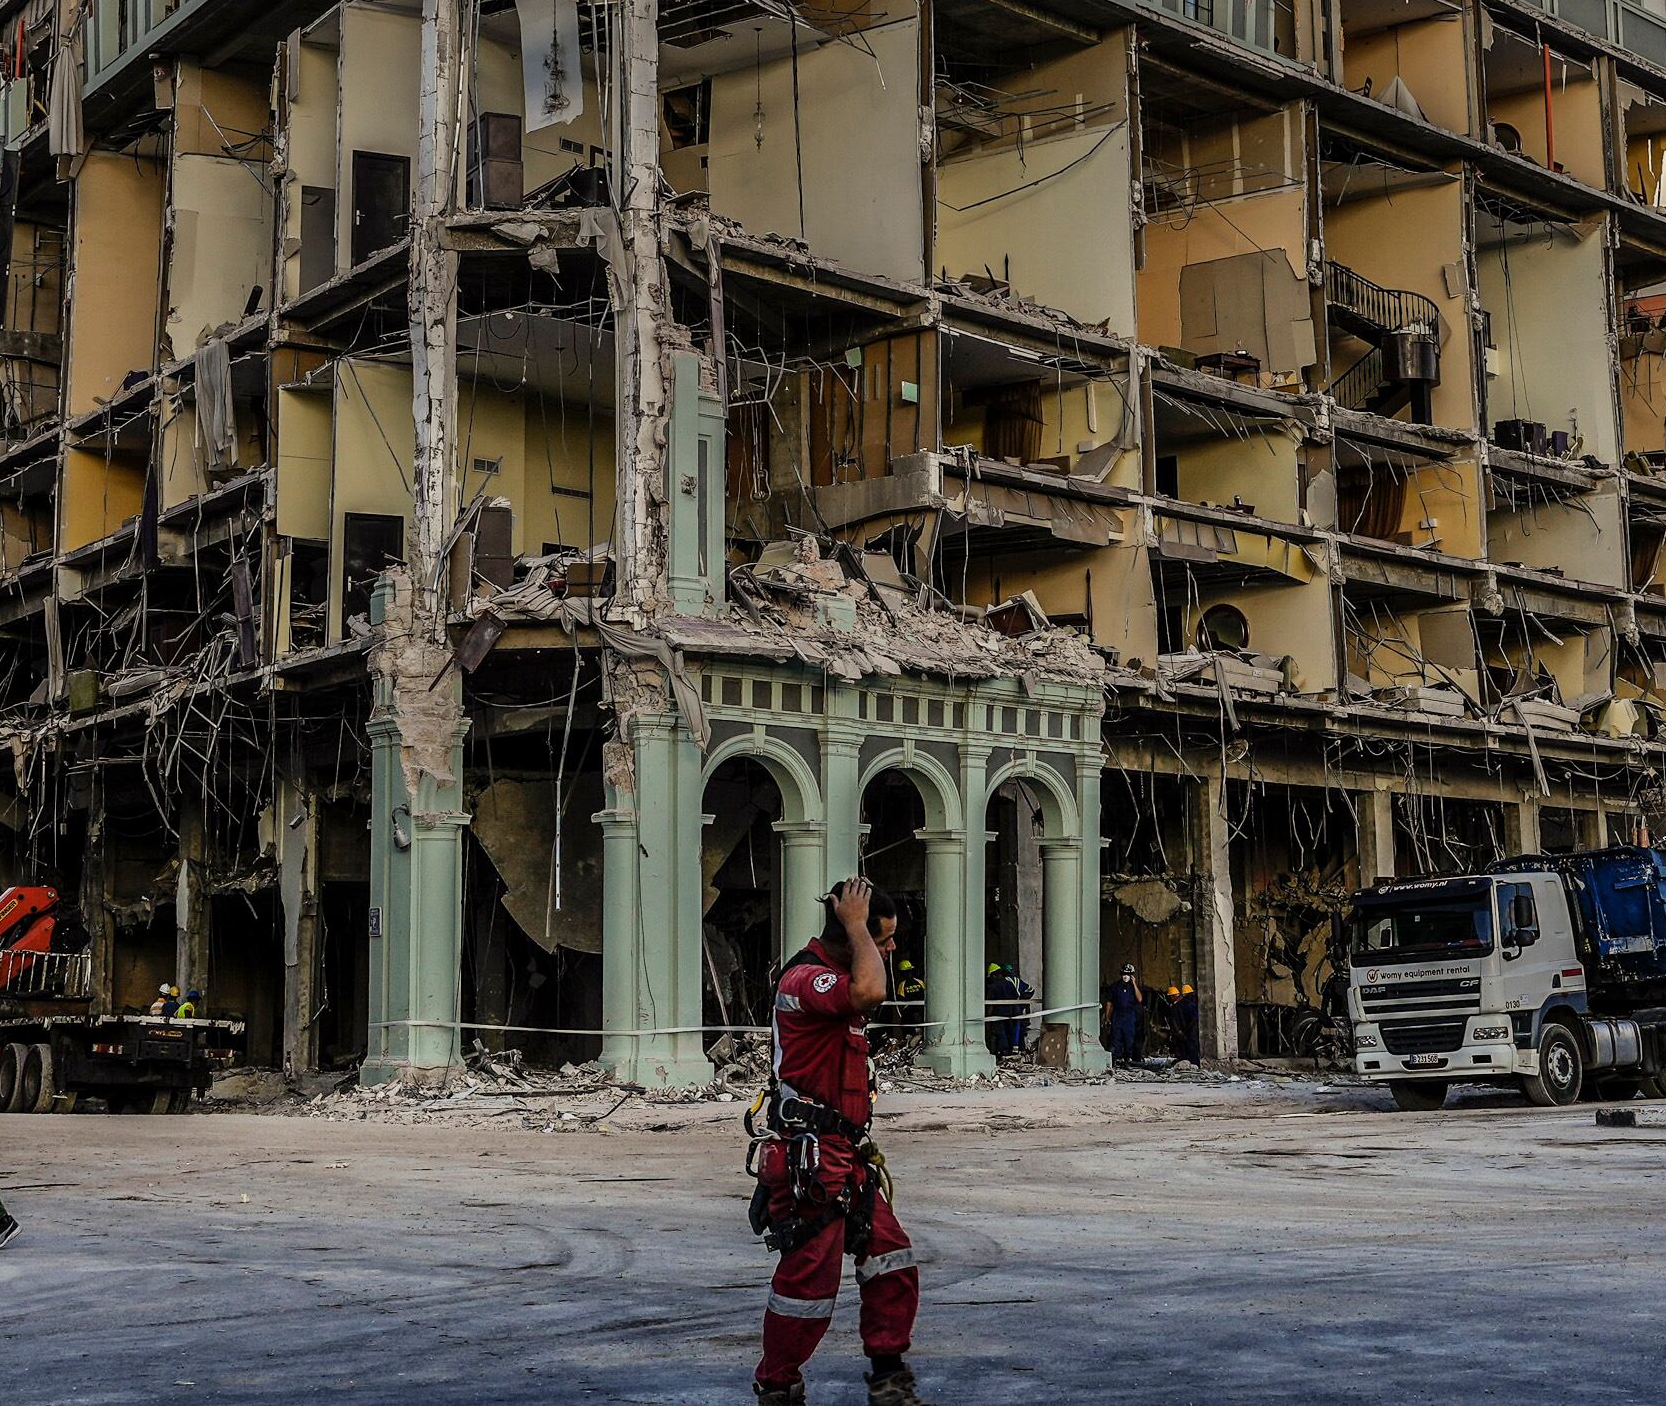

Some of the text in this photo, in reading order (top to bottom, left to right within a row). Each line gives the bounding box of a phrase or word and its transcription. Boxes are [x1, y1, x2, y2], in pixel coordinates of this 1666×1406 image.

[1393, 880, 1448, 891] www.womy.nl
[1404, 968, 1444, 979] equipment
[1446, 965, 1470, 975] rental
[1459, 979, 1480, 988] CF
[1362, 986, 1386, 994] DAF
[1505, 1000, 1520, 1009] 0130
